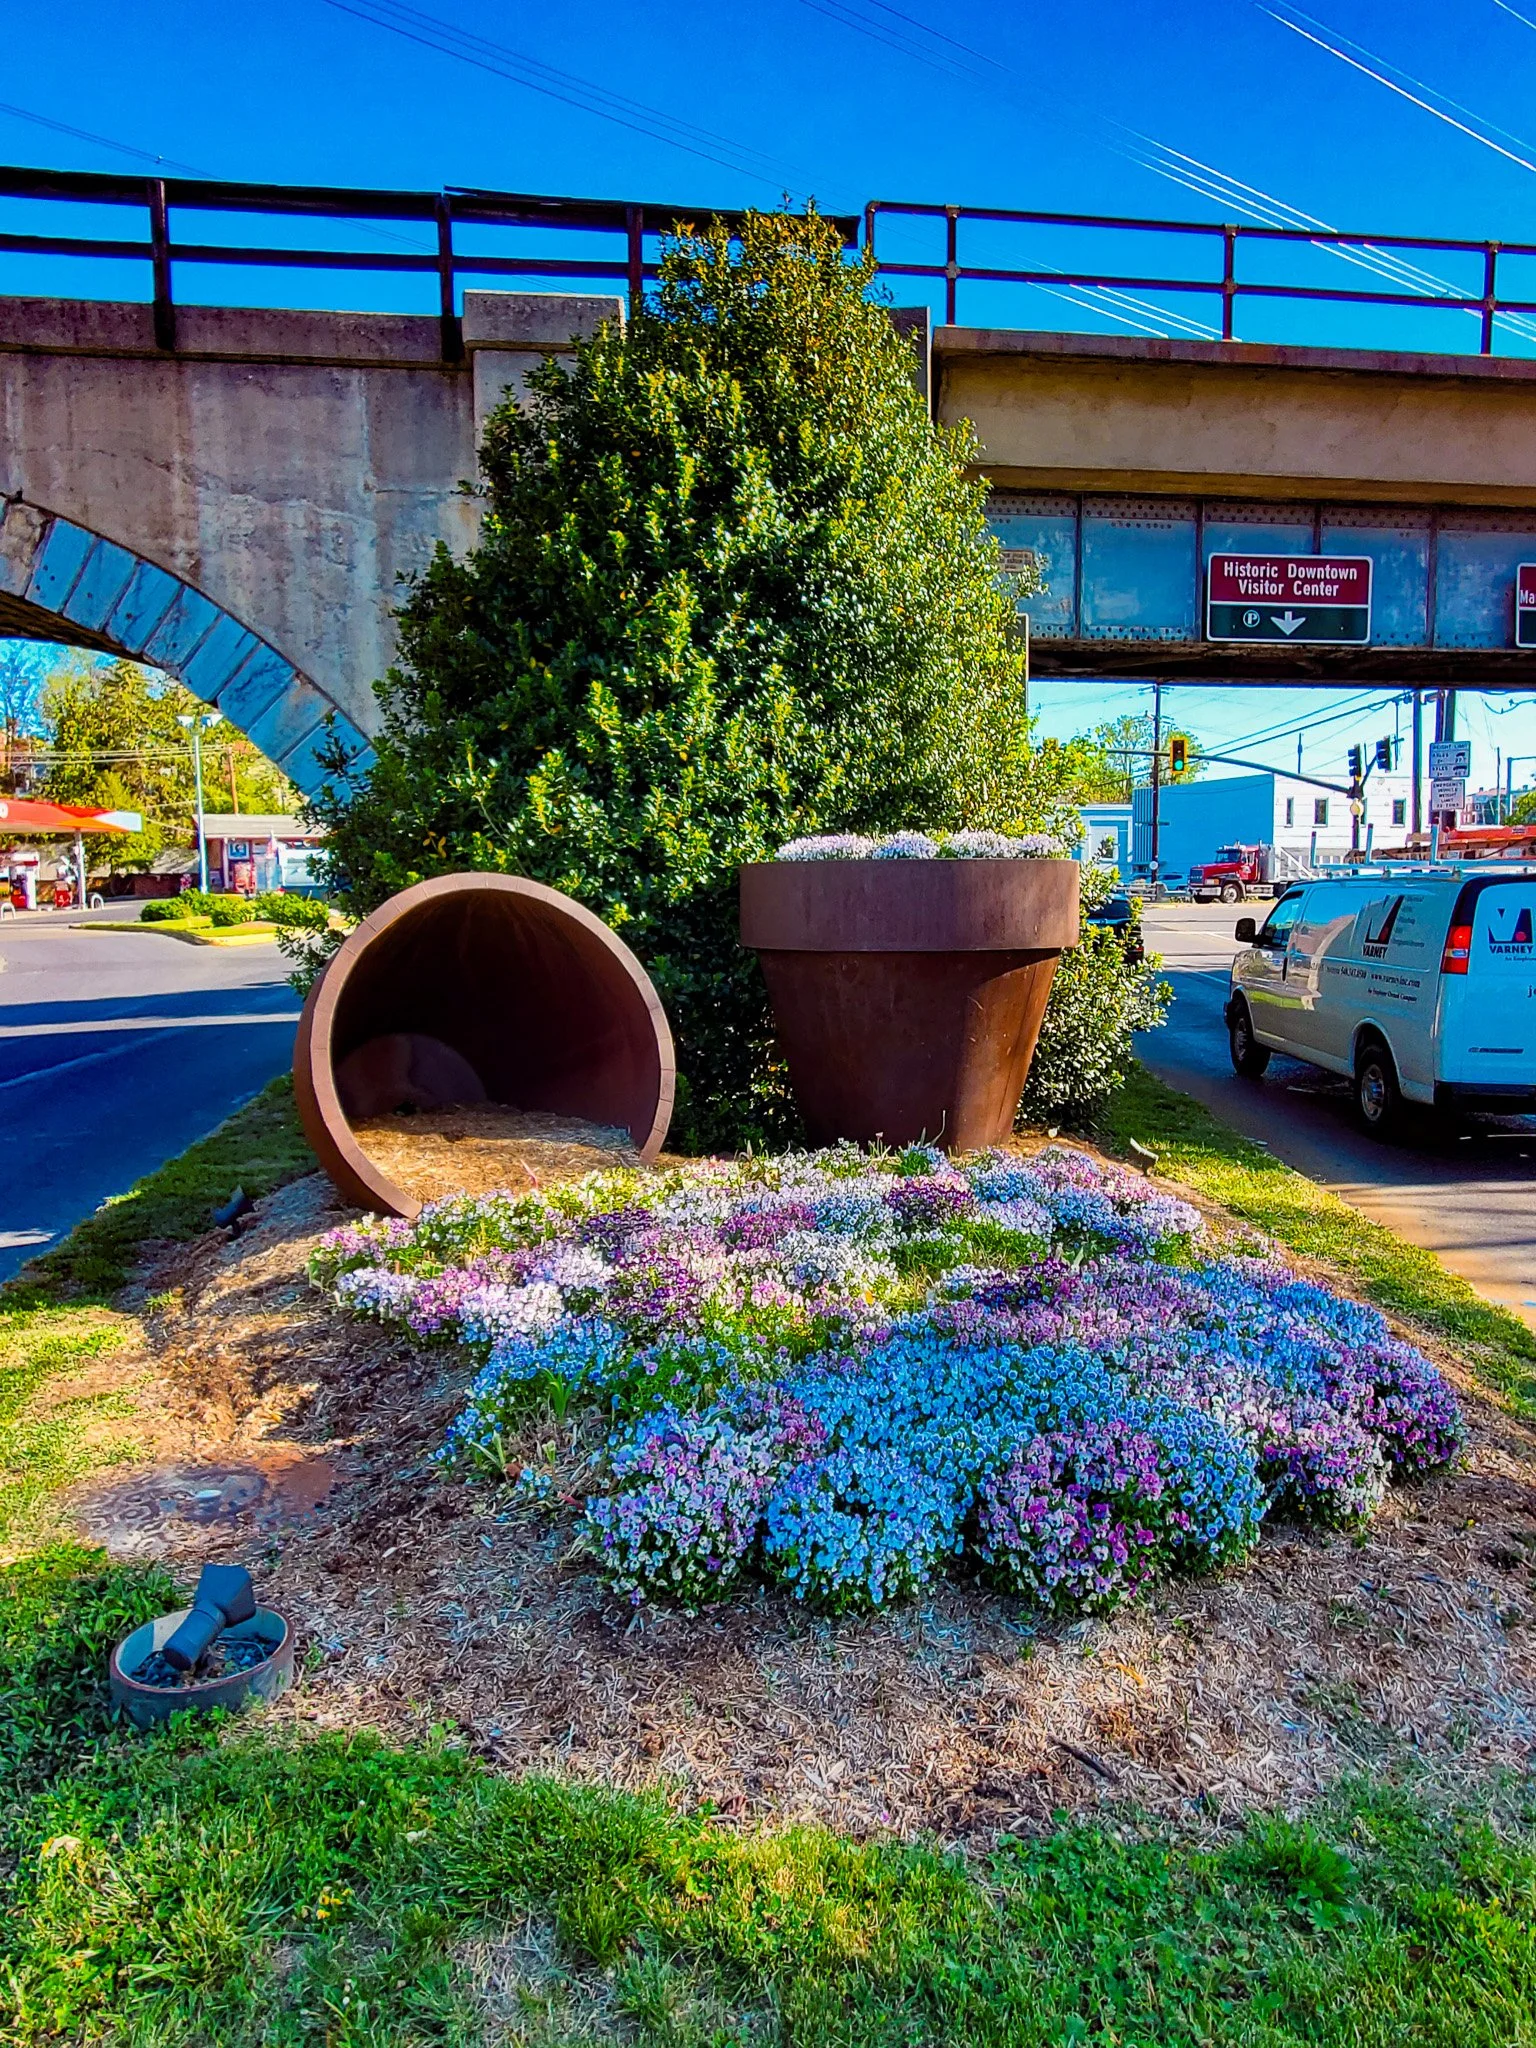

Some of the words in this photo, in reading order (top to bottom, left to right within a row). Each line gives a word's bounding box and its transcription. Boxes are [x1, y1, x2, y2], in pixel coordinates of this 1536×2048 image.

[1223, 561, 1279, 578] Historic
[1287, 563, 1358, 580] Downtown
[1238, 579, 1285, 595] Visitor
[1293, 580, 1339, 597] Center
[1362, 944, 1389, 960] VARNEY
[1488, 945, 1533, 954] VARNEY
